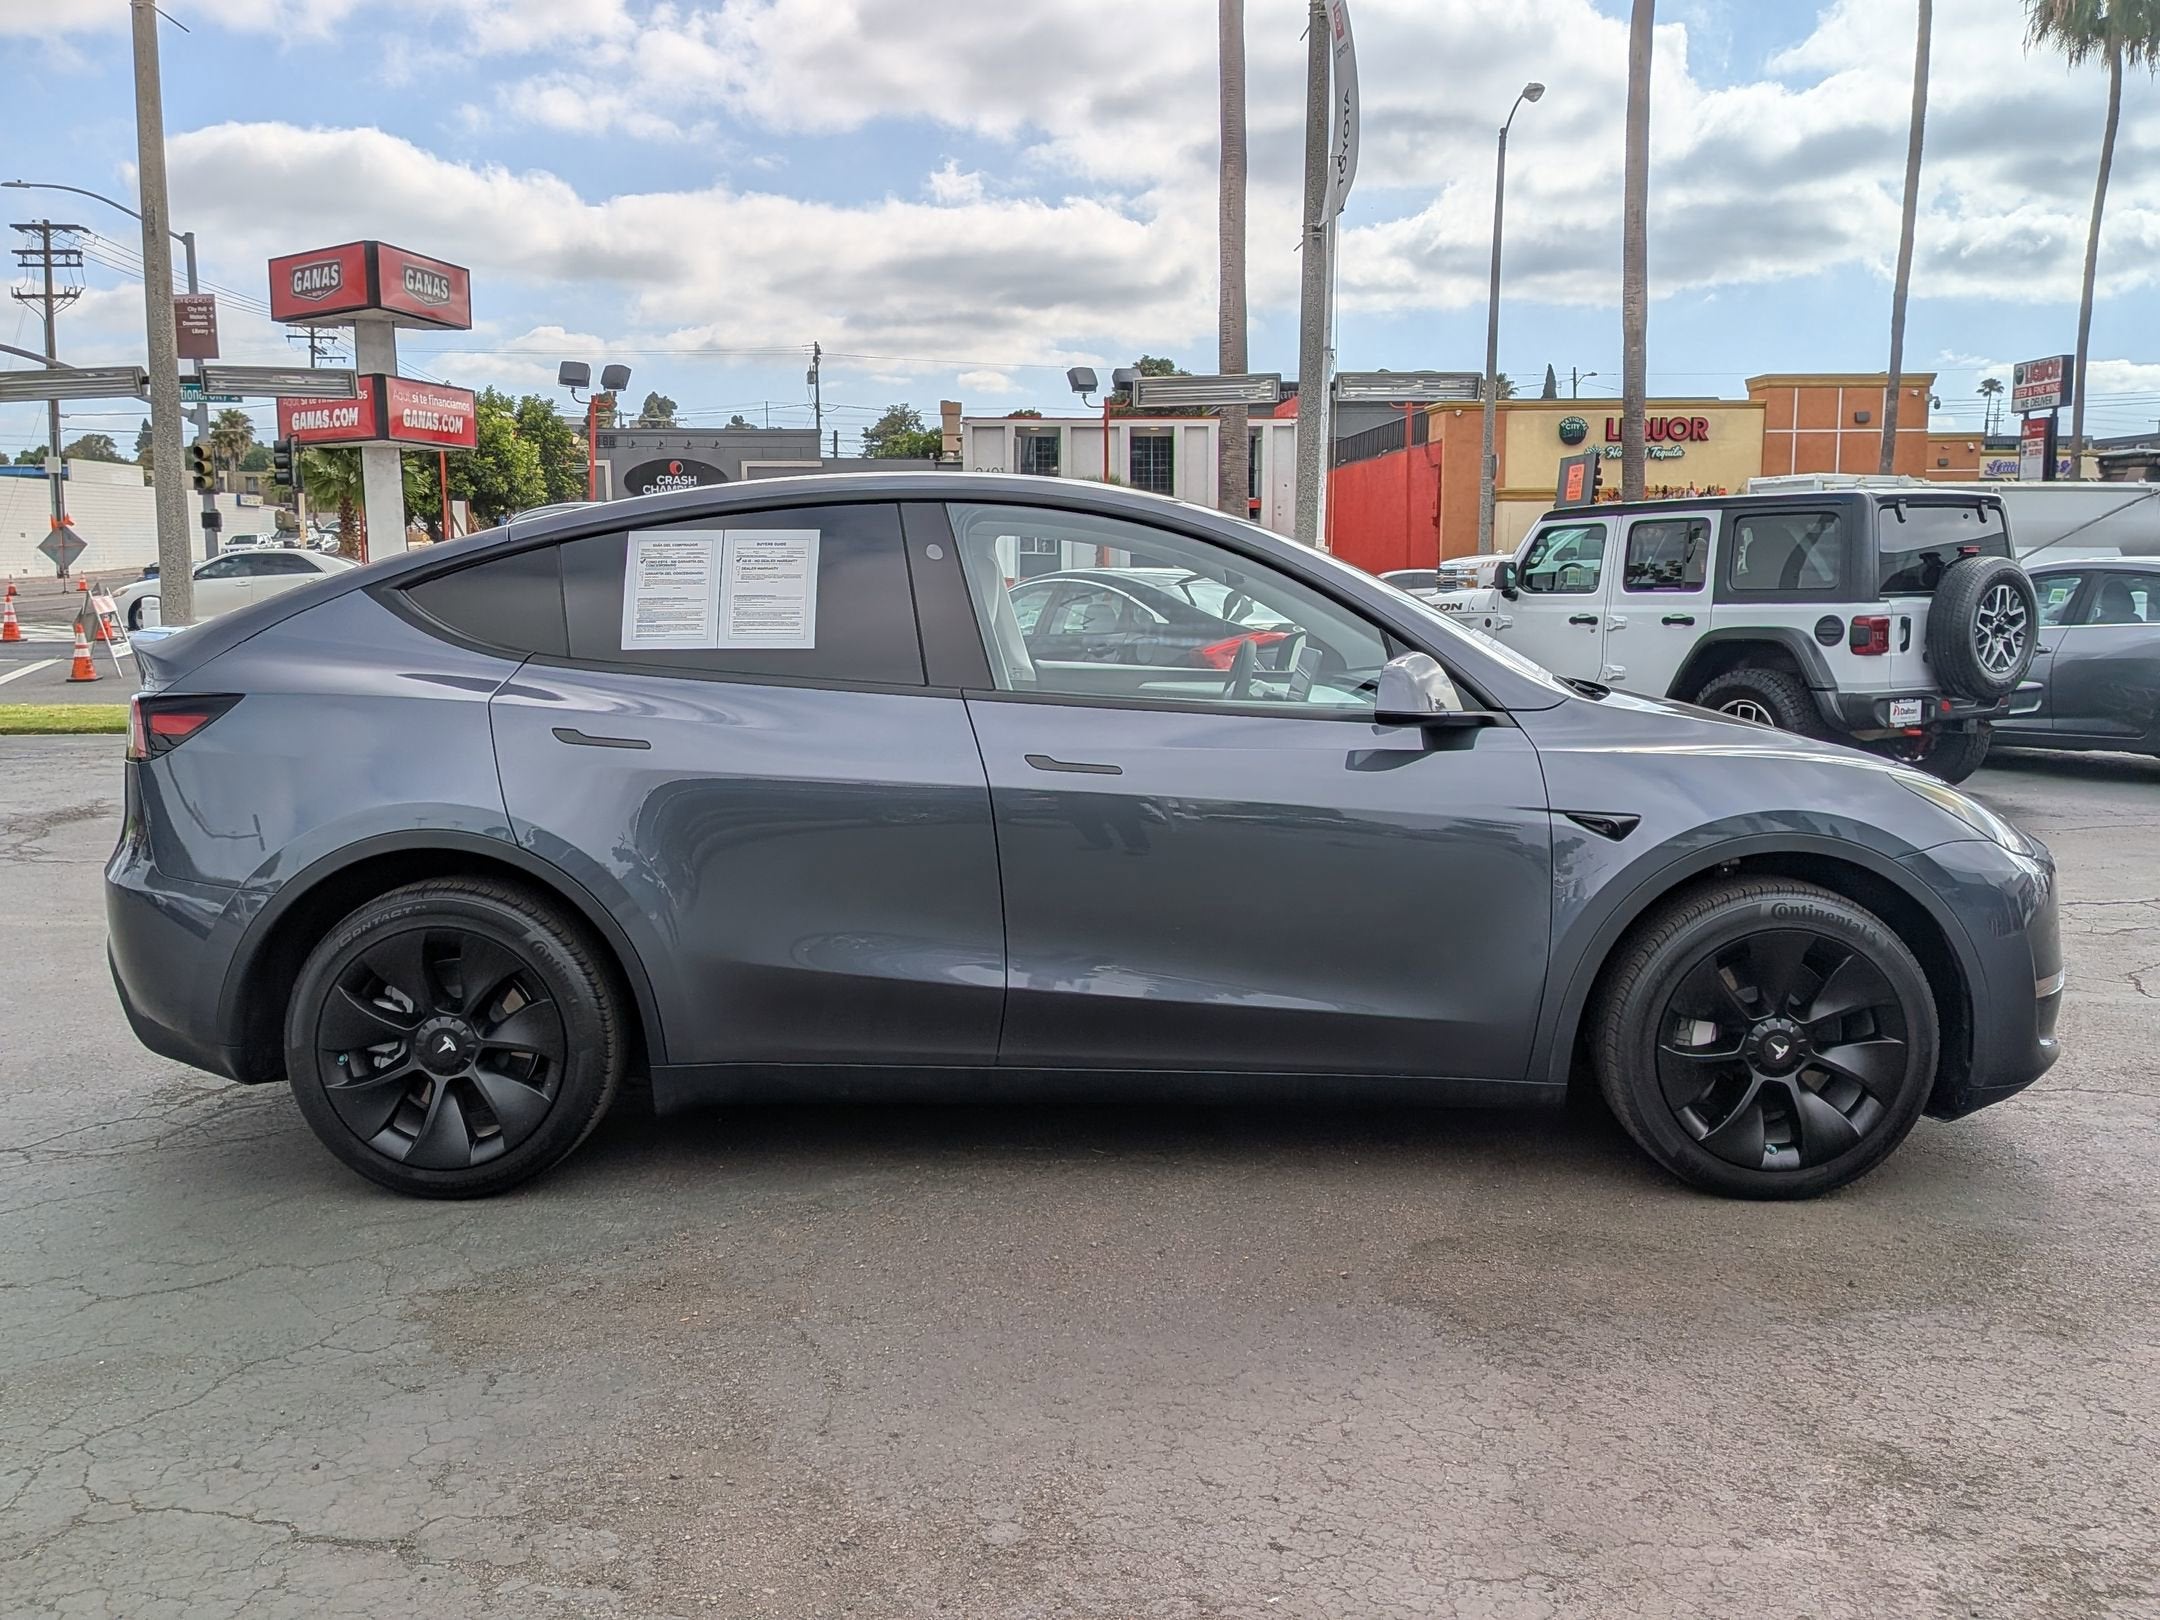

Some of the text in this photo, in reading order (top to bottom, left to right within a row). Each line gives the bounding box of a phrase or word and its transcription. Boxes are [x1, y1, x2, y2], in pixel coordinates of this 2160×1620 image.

[1337, 87, 1350, 190] TOYOTA
[294, 264, 339, 293] GANAS
[405, 268, 449, 299] GANAS
[192, 328, 209, 336] Library
[2025, 358, 2061, 385] LIQUOR
[2033, 385, 2046, 396] FINE
[2046, 382, 2060, 394] WINE
[420, 393, 428, 405] te
[428, 394, 470, 412] financiamos
[2021, 396, 2053, 408] WE DELIVER
[291, 407, 359, 431] GANAS.COM
[402, 408, 464, 434] GANAS.COM
[1560, 417, 1588, 431] NATIONAL
[1605, 416, 1709, 441] LIUOR
[1651, 445, 1684, 460] Tequila
[656, 475, 697, 485] CRASH
[1770, 902, 1868, 933] Continental
